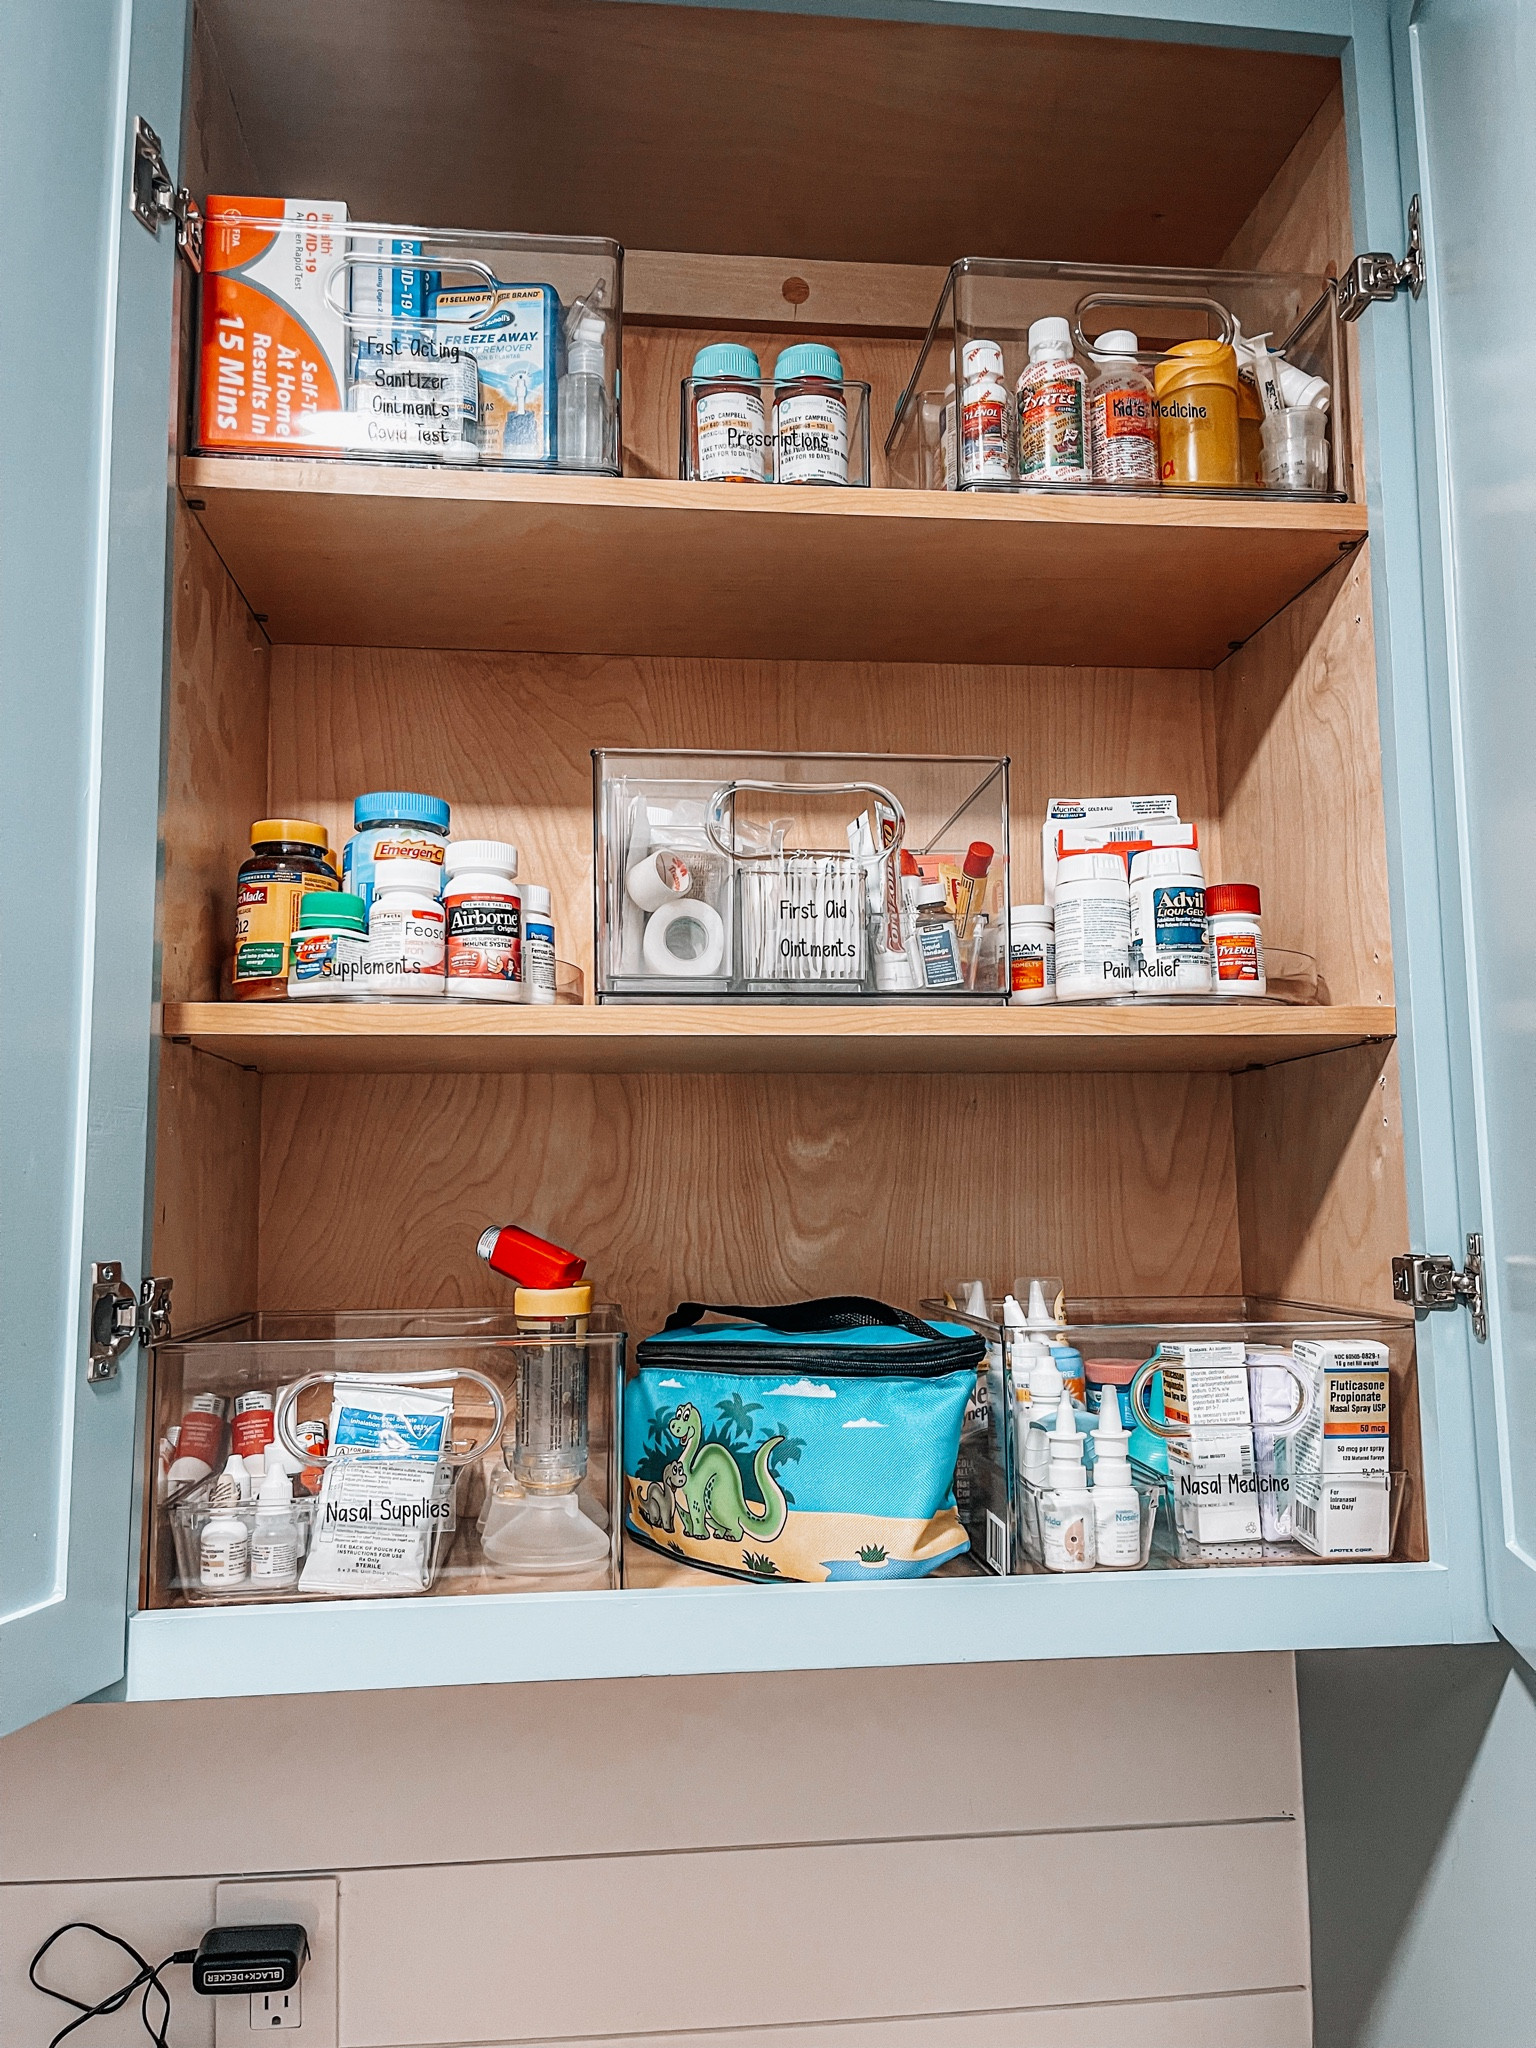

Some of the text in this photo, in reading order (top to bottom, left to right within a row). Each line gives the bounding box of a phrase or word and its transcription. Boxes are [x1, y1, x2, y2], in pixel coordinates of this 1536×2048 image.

[232, 229, 240, 246] FDA
[295, 273, 303, 290] Test
[376, 267, 384, 288] esting
[450, 290, 538, 302] SELLING BRAND
[367, 336, 403, 356] Fast
[444, 332, 538, 345] FREEZE AWAY
[482, 344, 532, 354] REMOVER
[217, 316, 246, 430] 15 Mins
[374, 368, 449, 389] Sanitizer
[251, 332, 272, 435] Results In
[275, 343, 302, 437] At Home
[373, 395, 450, 418] Ointments
[1023, 393, 1077, 412] ZYRTEC
[1113, 399, 1208, 418] Kid's Medicine
[718, 412, 747, 420] CAMPBELL
[805, 414, 832, 424] CAMPBELL
[368, 421, 450, 443] Covid Test
[728, 427, 829, 453] Prescriptions
[380, 844, 443, 860] Emergen-C
[780, 898, 848, 920] First Aid
[1156, 892, 1204, 908] Advil
[450, 910, 518, 930] Airborne
[1157, 908, 1204, 917] LIQUI-GELS
[497, 925, 518, 934] Original
[780, 938, 857, 958] Ointments
[1218, 946, 1256, 957] TYLENOL
[322, 956, 422, 982] Supplements
[1104, 960, 1132, 980] Pain
[1138, 958, 1180, 978] Relief
[1330, 1380, 1385, 1391] Fluticasone
[1330, 1392, 1381, 1404] Propionate
[1330, 1404, 1386, 1414] Nasal Spray USP
[350, 1418, 380, 1428] Inhalation
[1370, 1425, 1386, 1434] mcg
[1180, 1472, 1290, 1496] Nasal Medicine
[326, 1496, 450, 1527] Nasal Supplies
[207, 1971, 280, 1982] BLACK+DECKER
